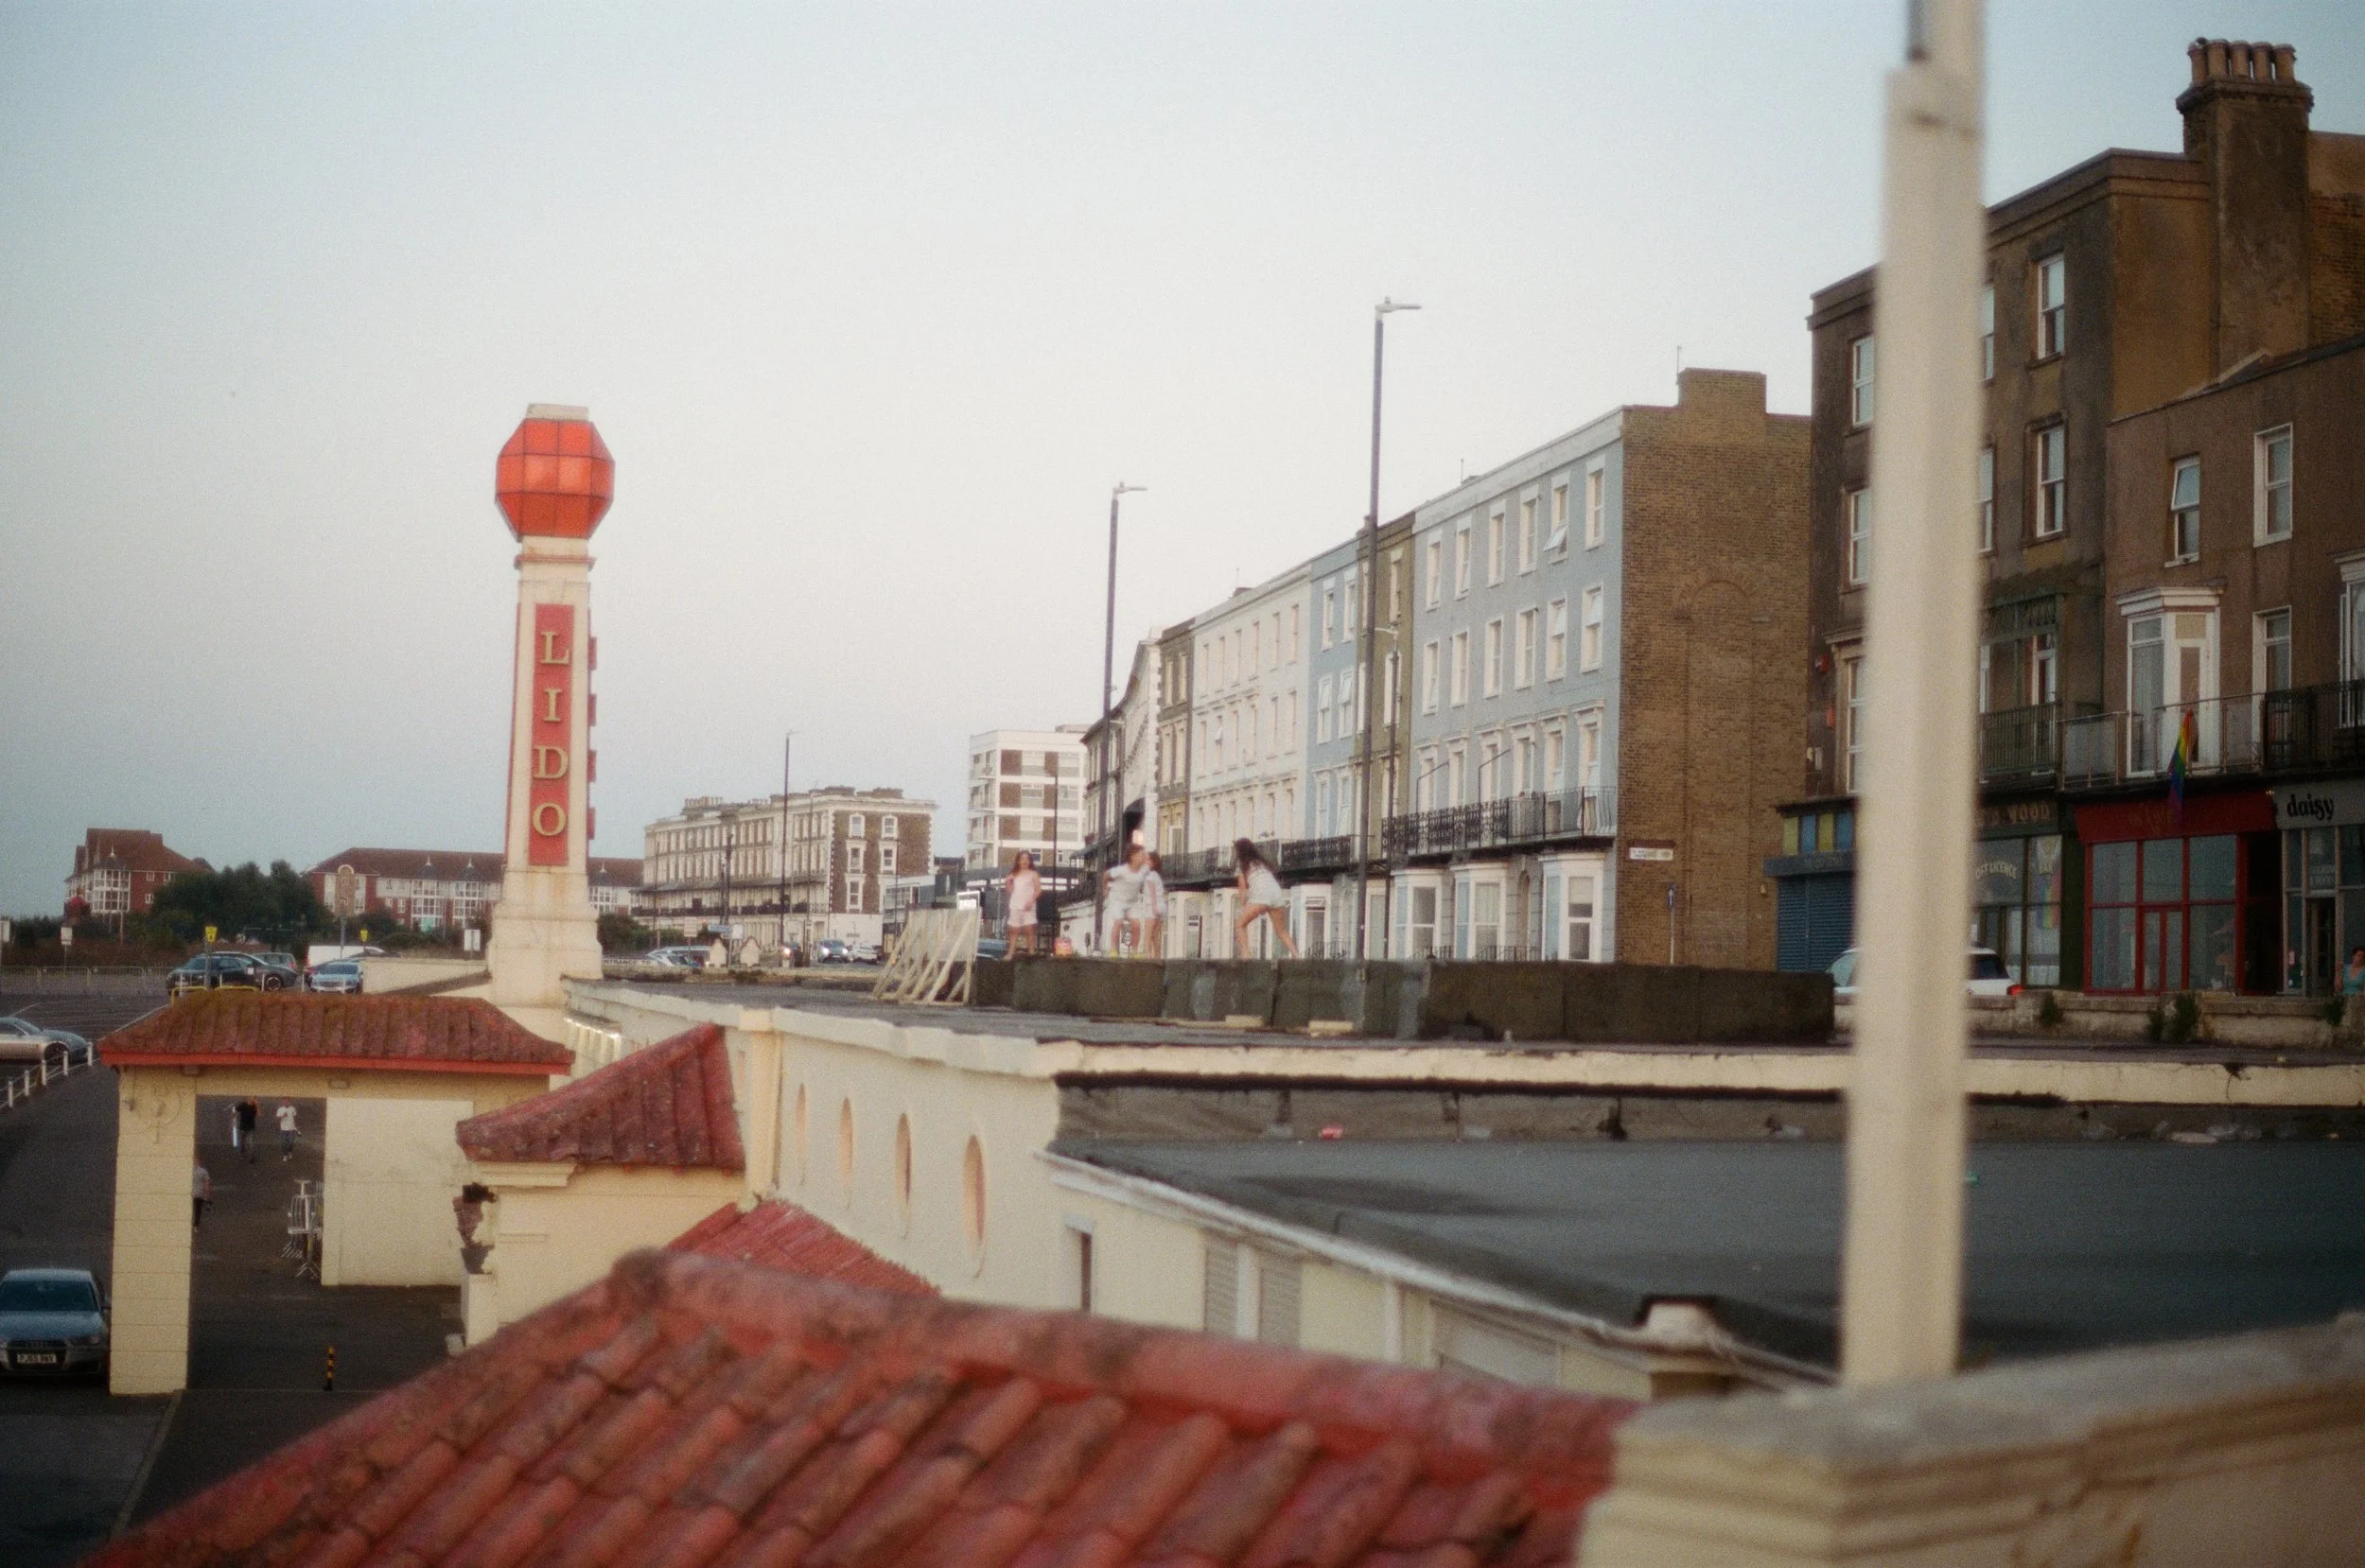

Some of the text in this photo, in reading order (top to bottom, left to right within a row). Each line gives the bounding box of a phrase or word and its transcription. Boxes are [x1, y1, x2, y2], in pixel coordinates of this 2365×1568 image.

[532, 631, 569, 836] LIDO
[2286, 793, 2335, 821] daisy
[1975, 861, 2017, 880] OFF LICENCE
